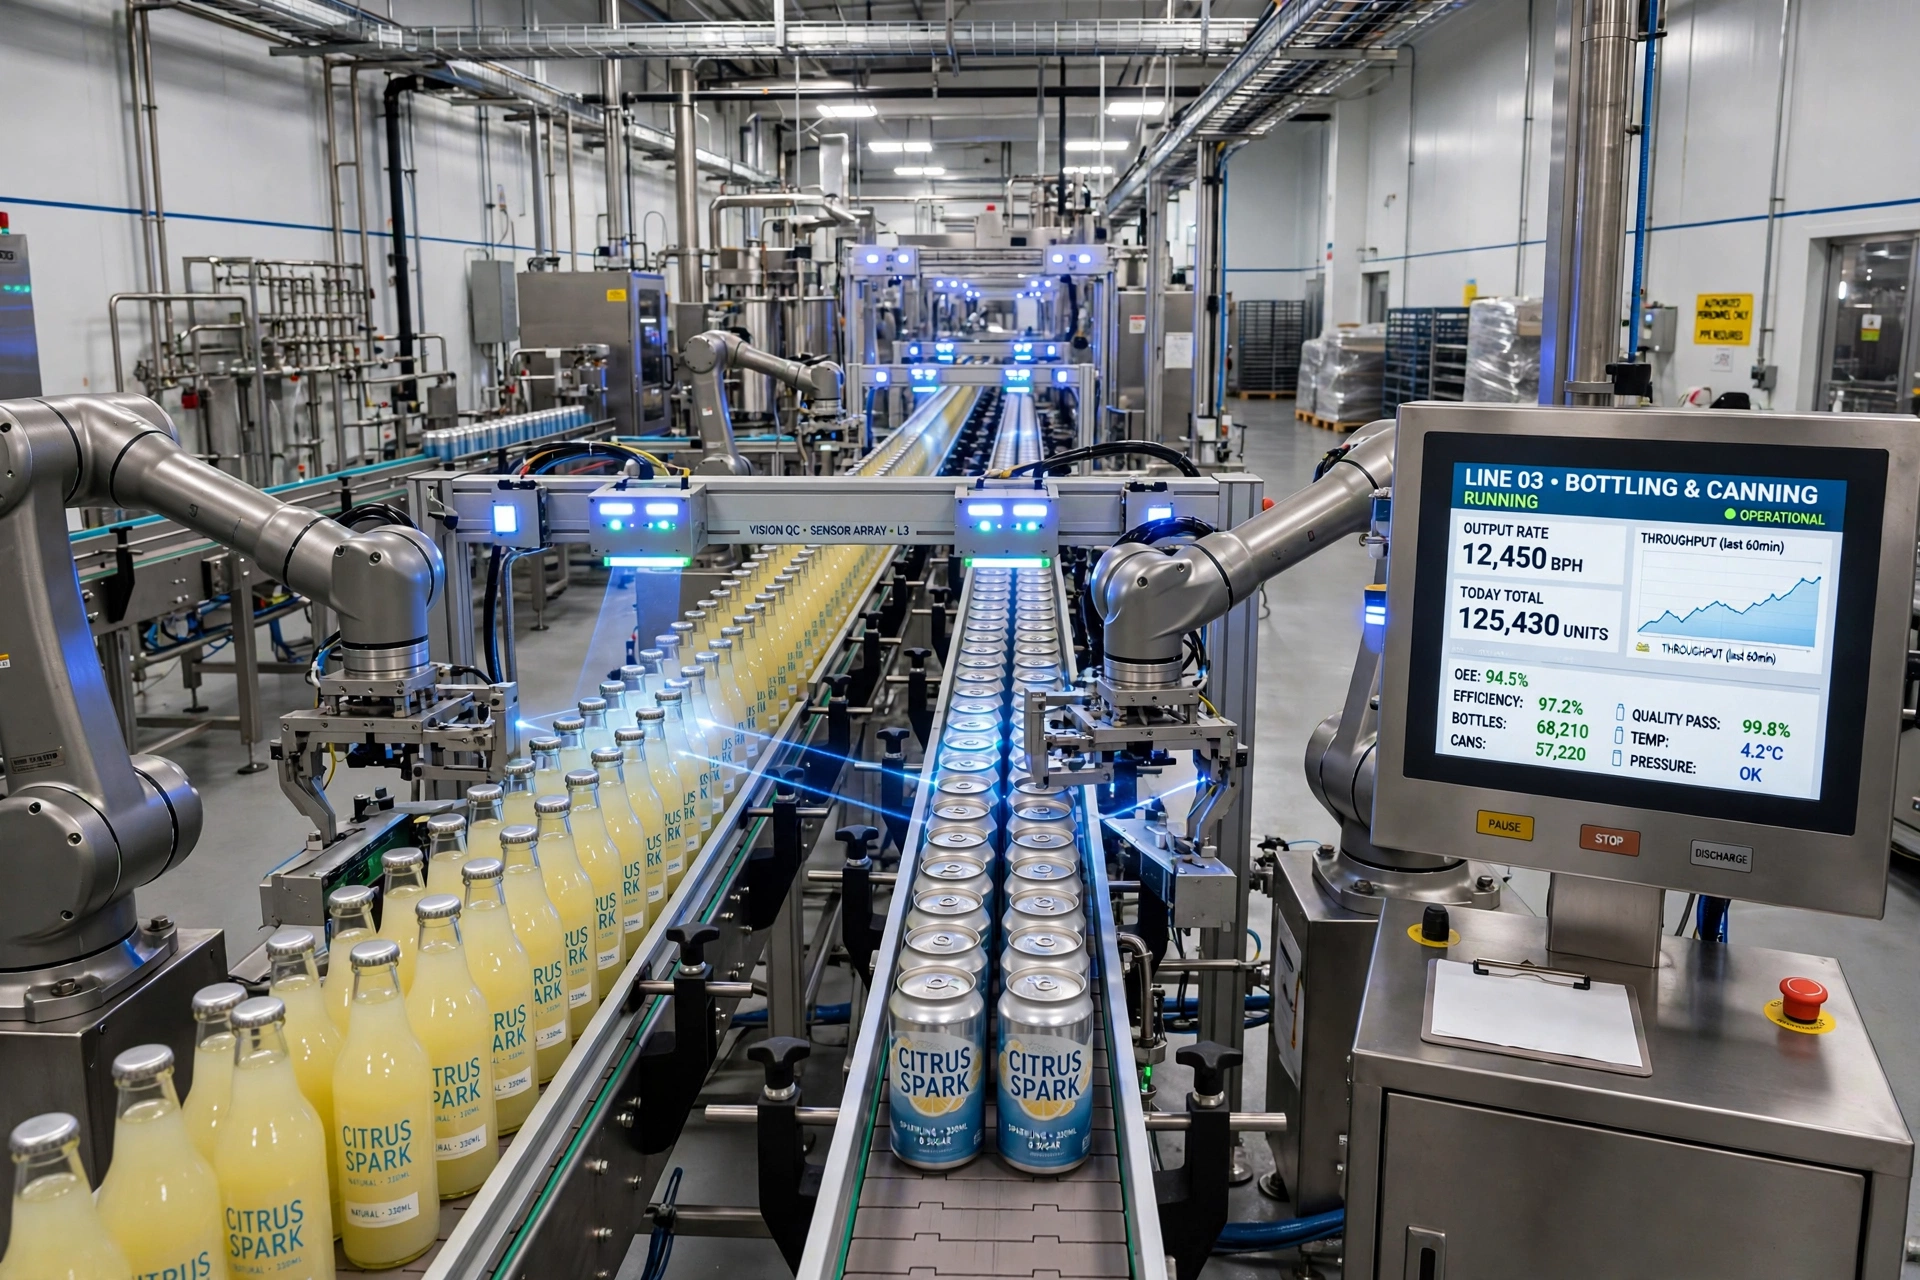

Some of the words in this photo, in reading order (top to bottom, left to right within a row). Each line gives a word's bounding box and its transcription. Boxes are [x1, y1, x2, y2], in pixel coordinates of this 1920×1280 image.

[1464, 491, 1539, 509] RUNNING
[1465, 468, 1513, 488] LINE
[1517, 470, 1544, 490] 03
[1565, 473, 1678, 497] BOTTLING
[1683, 478, 1701, 499] &
[1706, 480, 1819, 505] CANNING
[749, 525, 784, 536] VISION
[785, 525, 801, 536] QC
[810, 525, 851, 536] SENSOR
[853, 525, 887, 536] ARRAY
[897, 525, 910, 536] L3
[1463, 522, 1514, 537] OUTPUT
[1516, 525, 1550, 540] RATE
[1739, 509, 1826, 526] OPERATIONAL
[1641, 532, 1717, 548] THROUGHPUT
[1719, 537, 1744, 552] (last
[1746, 540, 1785, 555] 60min)
[1463, 542, 1547, 571] 12,450
[1551, 556, 1583, 573] BPH
[1460, 585, 1502, 601] TODAY
[1504, 589, 1544, 605] TOTAL
[1459, 606, 1560, 637] 125,430
[1563, 623, 1610, 641] UNITS
[1662, 643, 1723, 660] THROUGHPUT
[1454, 668, 1481, 683] OEE:
[1485, 669, 1529, 687] 94.5%
[1453, 689, 1524, 709] EFFICIENCY:
[1538, 697, 1583, 716] 97.2%
[1452, 711, 1507, 730] BOTTLES:
[1537, 720, 1589, 739] 68,210
[1632, 708, 1684, 726] QUALITY
[1685, 715, 1721, 731] PASS:
[1742, 719, 1791, 738] 99.8%
[1450, 733, 1487, 750] CANS:
[1535, 742, 1587, 761] 57,220
[1630, 731, 1669, 748] TEMP:
[1740, 742, 1784, 761] 4.2°C
[1630, 754, 1697, 775] PRESSURE:
[1739, 766, 1762, 783] OK
[1488, 818, 1521, 833] PAUSE
[1595, 833, 1624, 847] STOP
[1695, 848, 1749, 866] DISCHARGE
[534, 960, 562, 987] RUS
[534, 979, 562, 1005] ARK
[494, 1003, 526, 1032] RUS
[493, 1024, 526, 1053] ARK
[432, 1057, 480, 1087] TRUS
[899, 1046, 971, 1074] CITRUS
[1009, 1050, 1082, 1077] CITRUS
[433, 1078, 481, 1109] ARK
[901, 1071, 969, 1098] SPARK
[1011, 1074, 1080, 1101] SPARK
[342, 1119, 412, 1149] CITRUS
[345, 1142, 412, 1174] SPARK
[226, 1199, 304, 1234] CITRUS
[230, 1224, 304, 1260] SPARK
